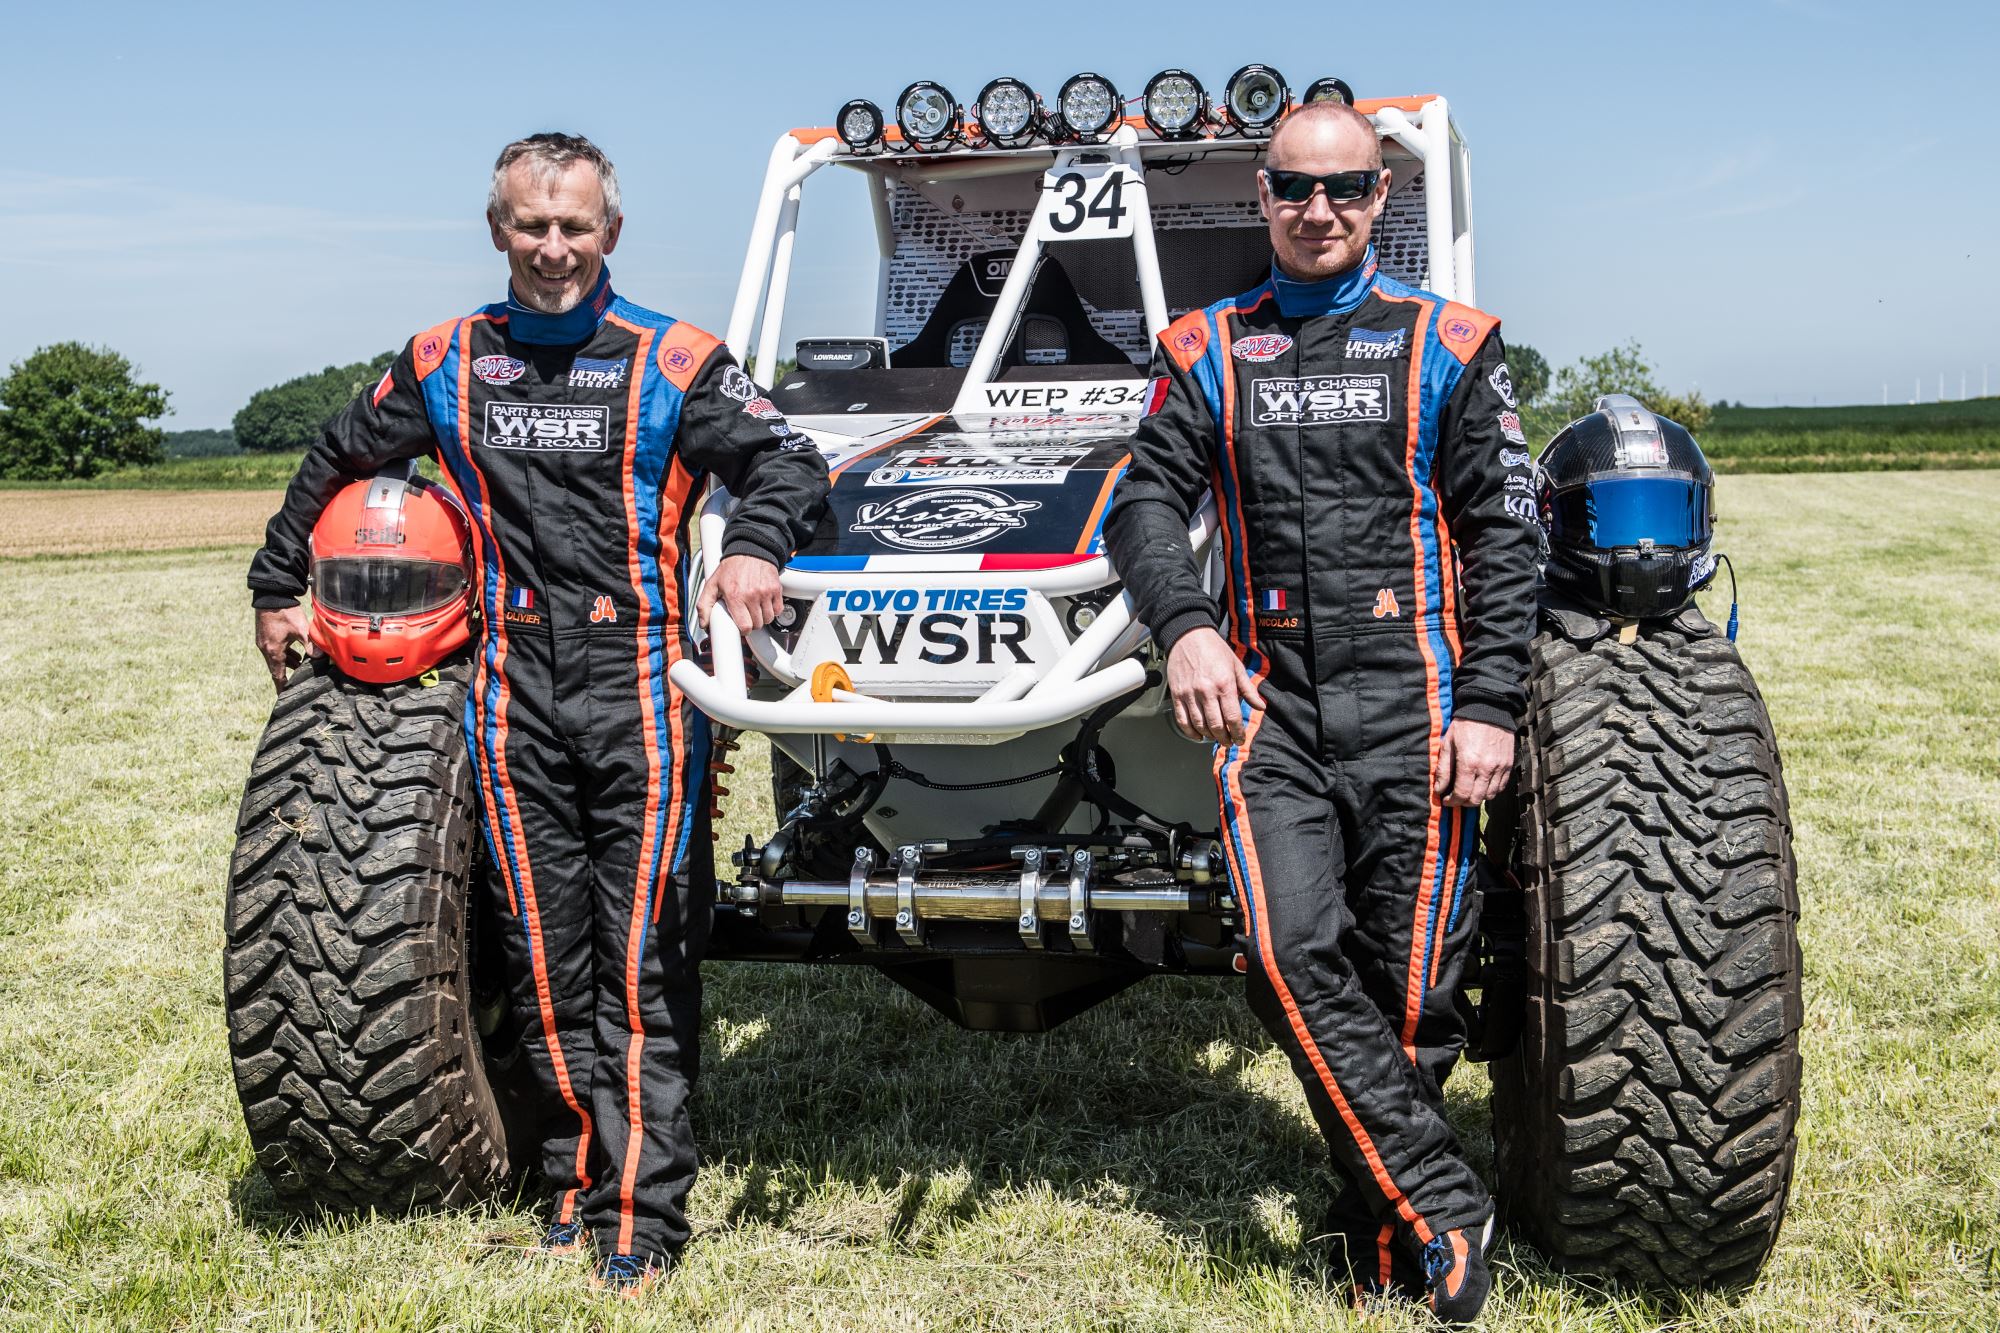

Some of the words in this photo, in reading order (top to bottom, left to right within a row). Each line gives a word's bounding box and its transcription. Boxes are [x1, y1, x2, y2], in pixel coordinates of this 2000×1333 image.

[1049, 171, 1127, 233] 34
[987, 261, 1014, 276] OM
[1244, 334, 1293, 358] WEP
[813, 353, 854, 361] LOWRANCE
[1345, 350, 1399, 360] EUROPE
[482, 357, 525, 378] WEP
[568, 380, 619, 389] EUROPE
[1258, 381, 1300, 393] PARTS
[1304, 381, 1315, 391] &
[1318, 378, 1382, 390] CHASSIS
[985, 388, 1069, 407] WEP
[1259, 388, 1383, 412] WSR
[491, 405, 529, 417] PARTS
[531, 408, 541, 418] &
[544, 408, 603, 419] CHASSIS
[1258, 411, 1306, 422] OFF
[1312, 407, 1383, 421] ROAD
[491, 416, 602, 439] WSR
[491, 436, 531, 447] OFF
[536, 438, 602, 448] ROAD
[899, 522, 953, 530] Lighting
[826, 589, 919, 612] TOYO
[924, 588, 1028, 611] TIRES
[1373, 588, 1400, 619] 34
[590, 595, 617, 623] 34
[506, 612, 541, 625] OLIVIER
[1258, 617, 1299, 628] NICOLAS
[828, 613, 1036, 665] WSR
